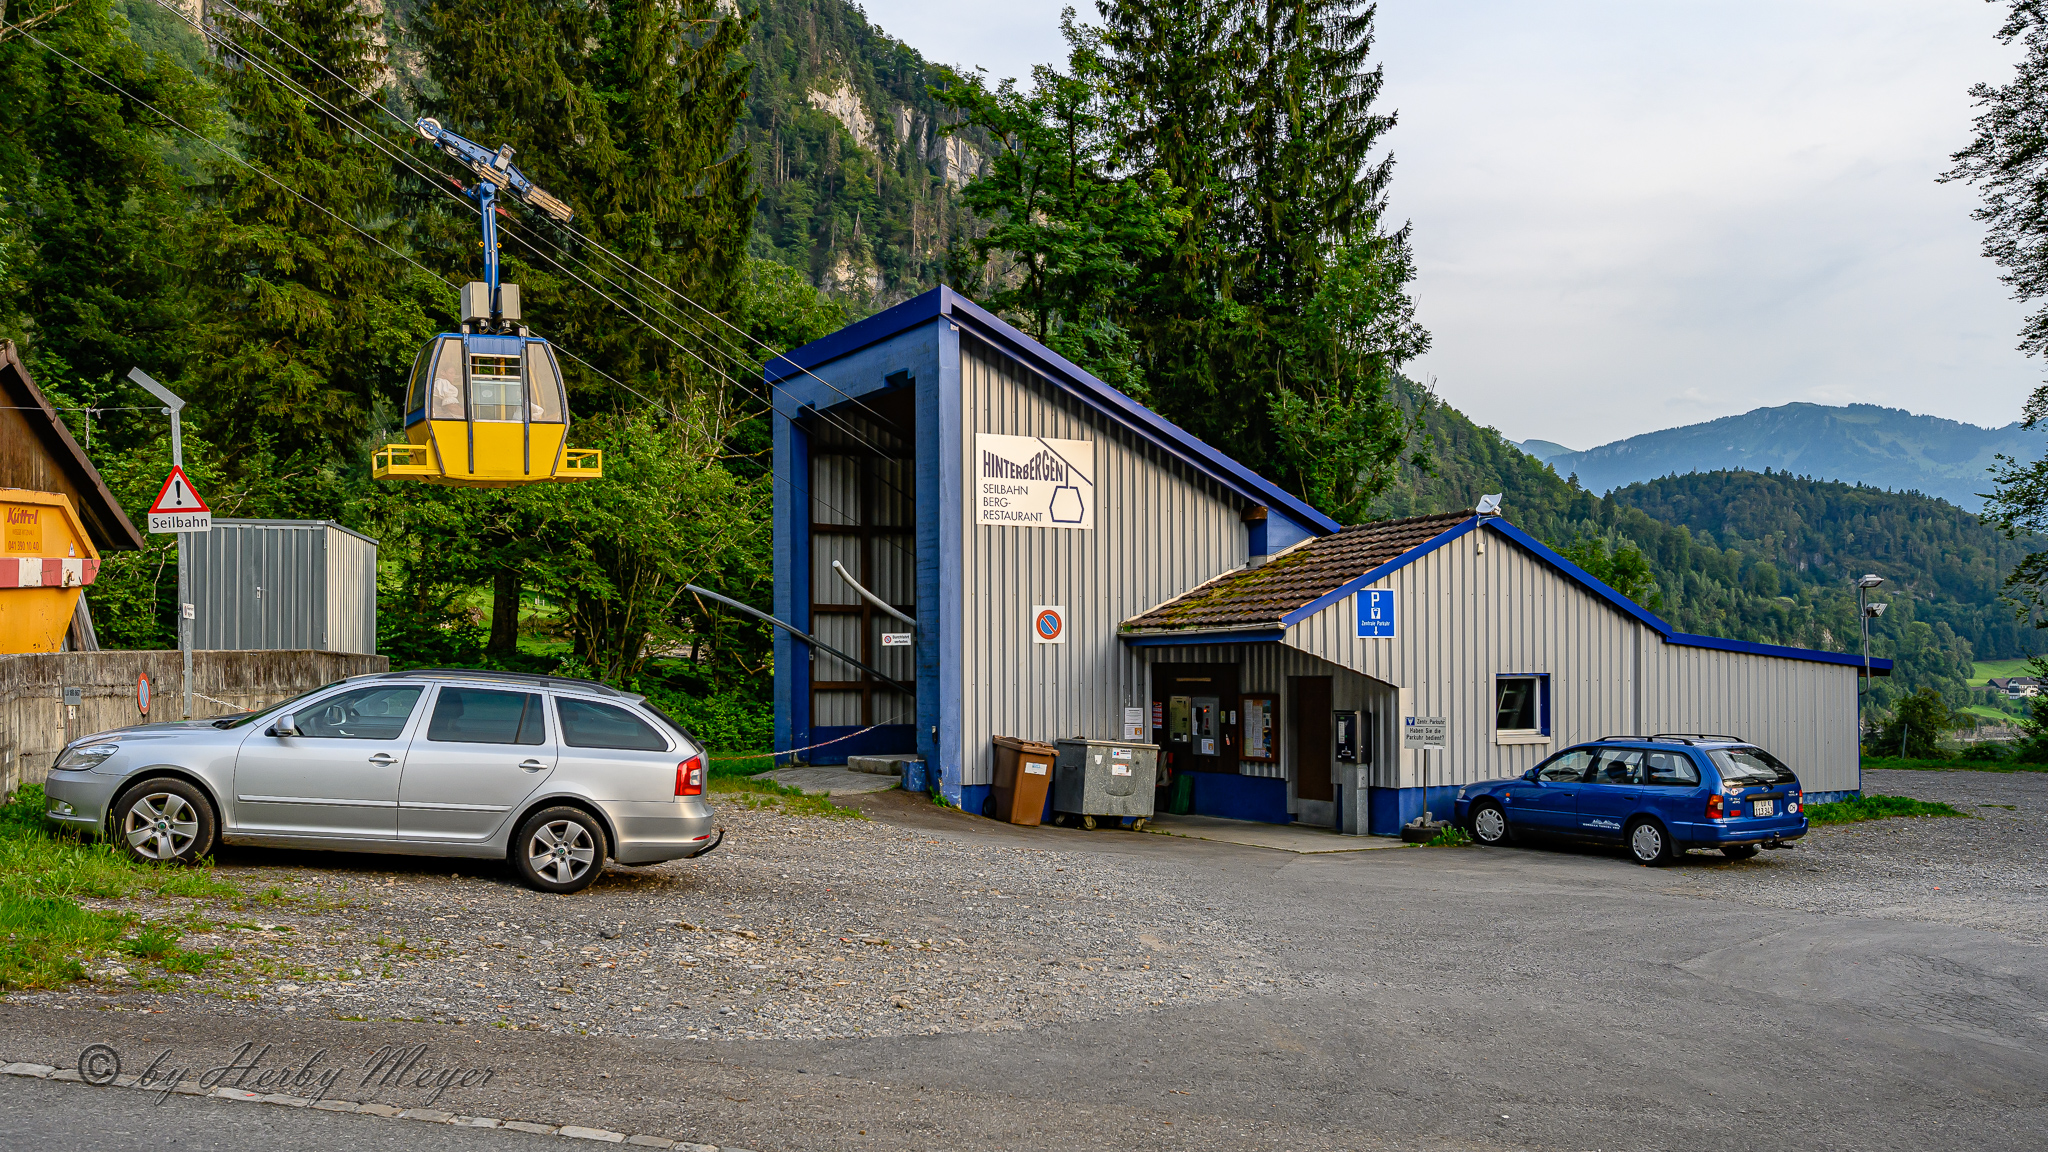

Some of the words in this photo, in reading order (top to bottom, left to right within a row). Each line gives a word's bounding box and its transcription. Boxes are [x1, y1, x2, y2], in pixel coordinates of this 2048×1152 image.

[983, 449, 1063, 482] HINTERBERGEN
[983, 483, 1029, 495] SEILBAHN
[983, 497, 1011, 508] BERG-
[983, 509, 1043, 522] RESTAURANT
[152, 516, 208, 529] Seilbahn
[1371, 592, 1380, 607] P
